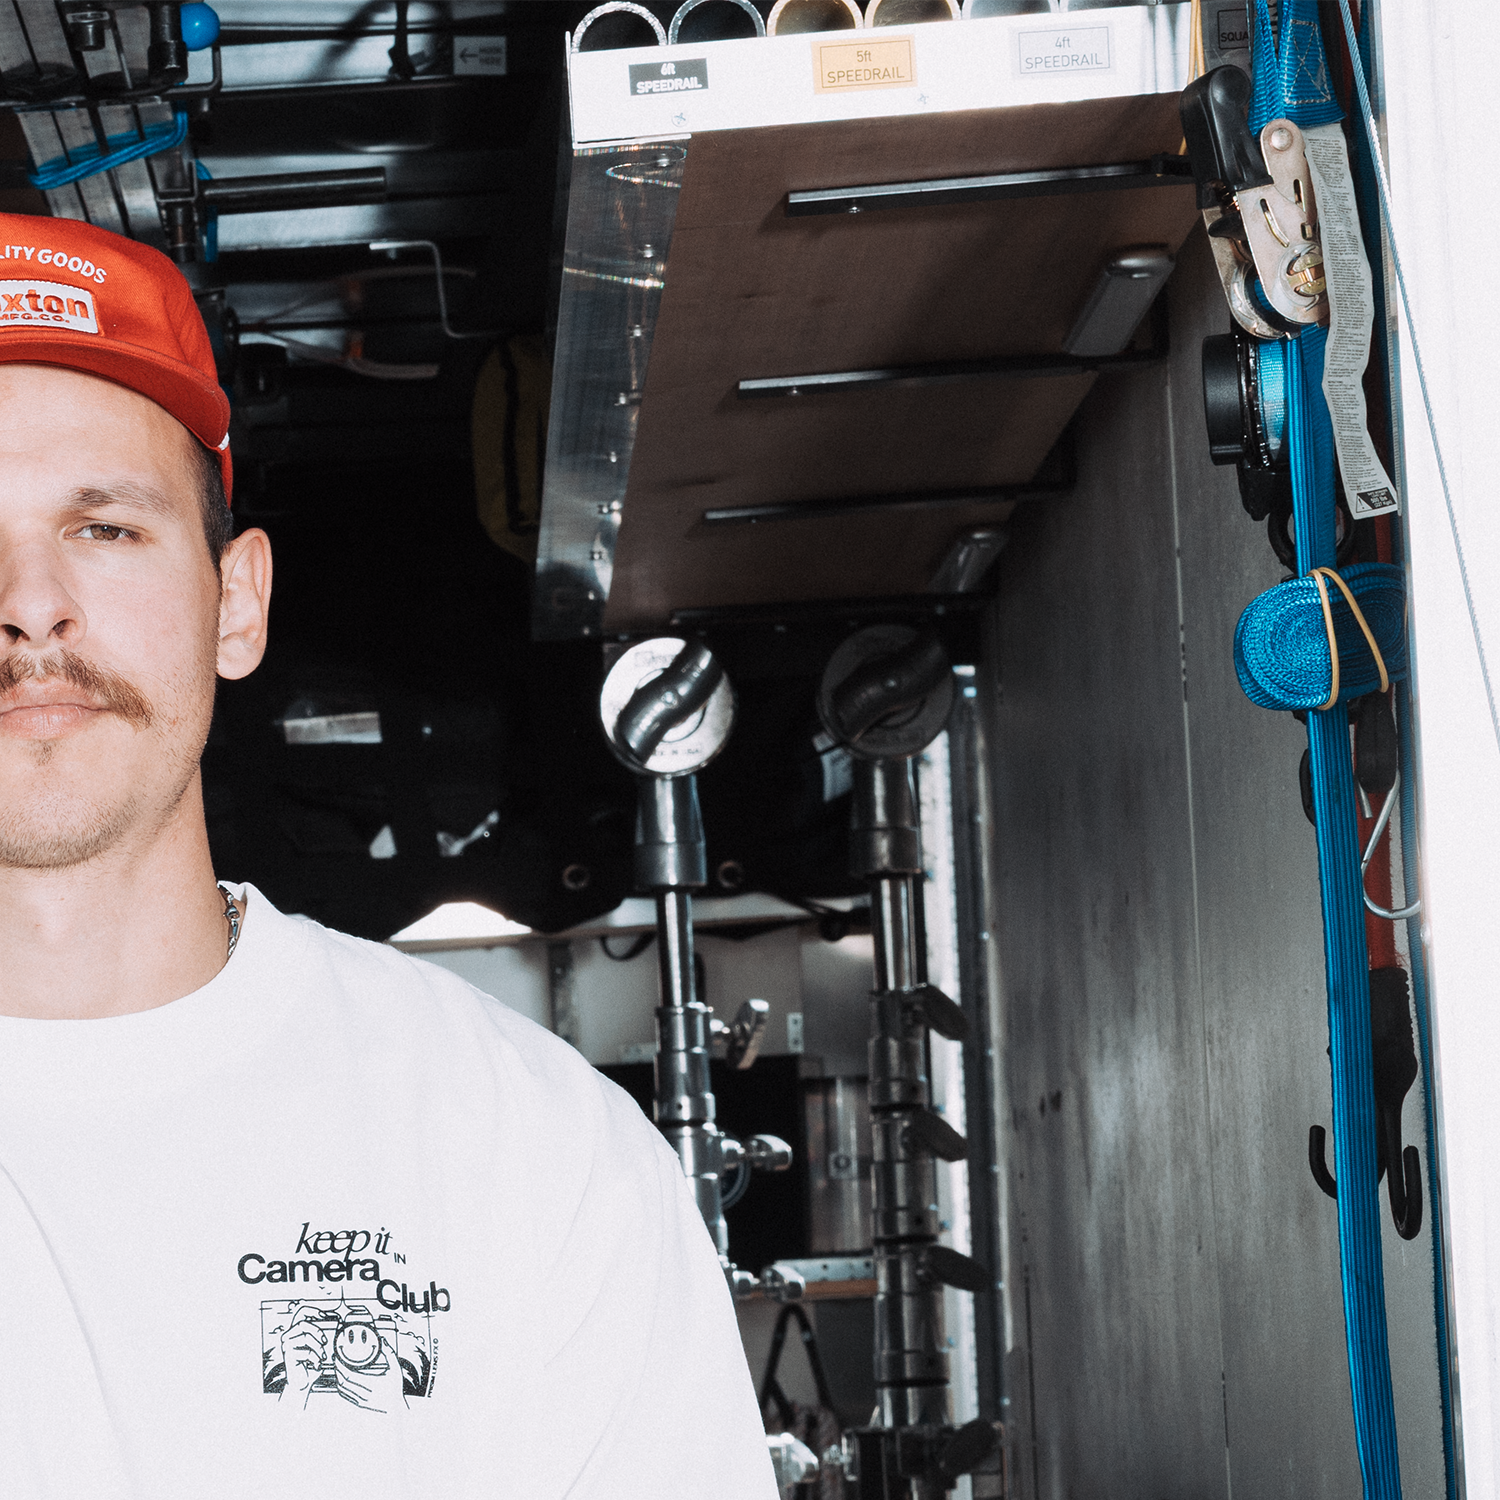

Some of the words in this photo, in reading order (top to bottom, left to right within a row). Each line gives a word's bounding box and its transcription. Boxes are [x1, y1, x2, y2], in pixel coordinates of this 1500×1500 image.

[1055, 36, 1071, 48] 4ft
[856, 50, 872, 63] 5ft
[1025, 53, 1103, 70] SPEEDRAIL
[660, 62, 676, 76] 6ft
[827, 66, 905, 84] SPEEDRAIL
[636, 76, 703, 94] SPEEDRAIL
[37, 248, 108, 284] GOODS
[295, 1222, 371, 1263] keep
[375, 1227, 393, 1255] it
[394, 1252, 407, 1264] IN
[237, 1253, 381, 1284] Camera
[376, 1278, 451, 1313] Club
